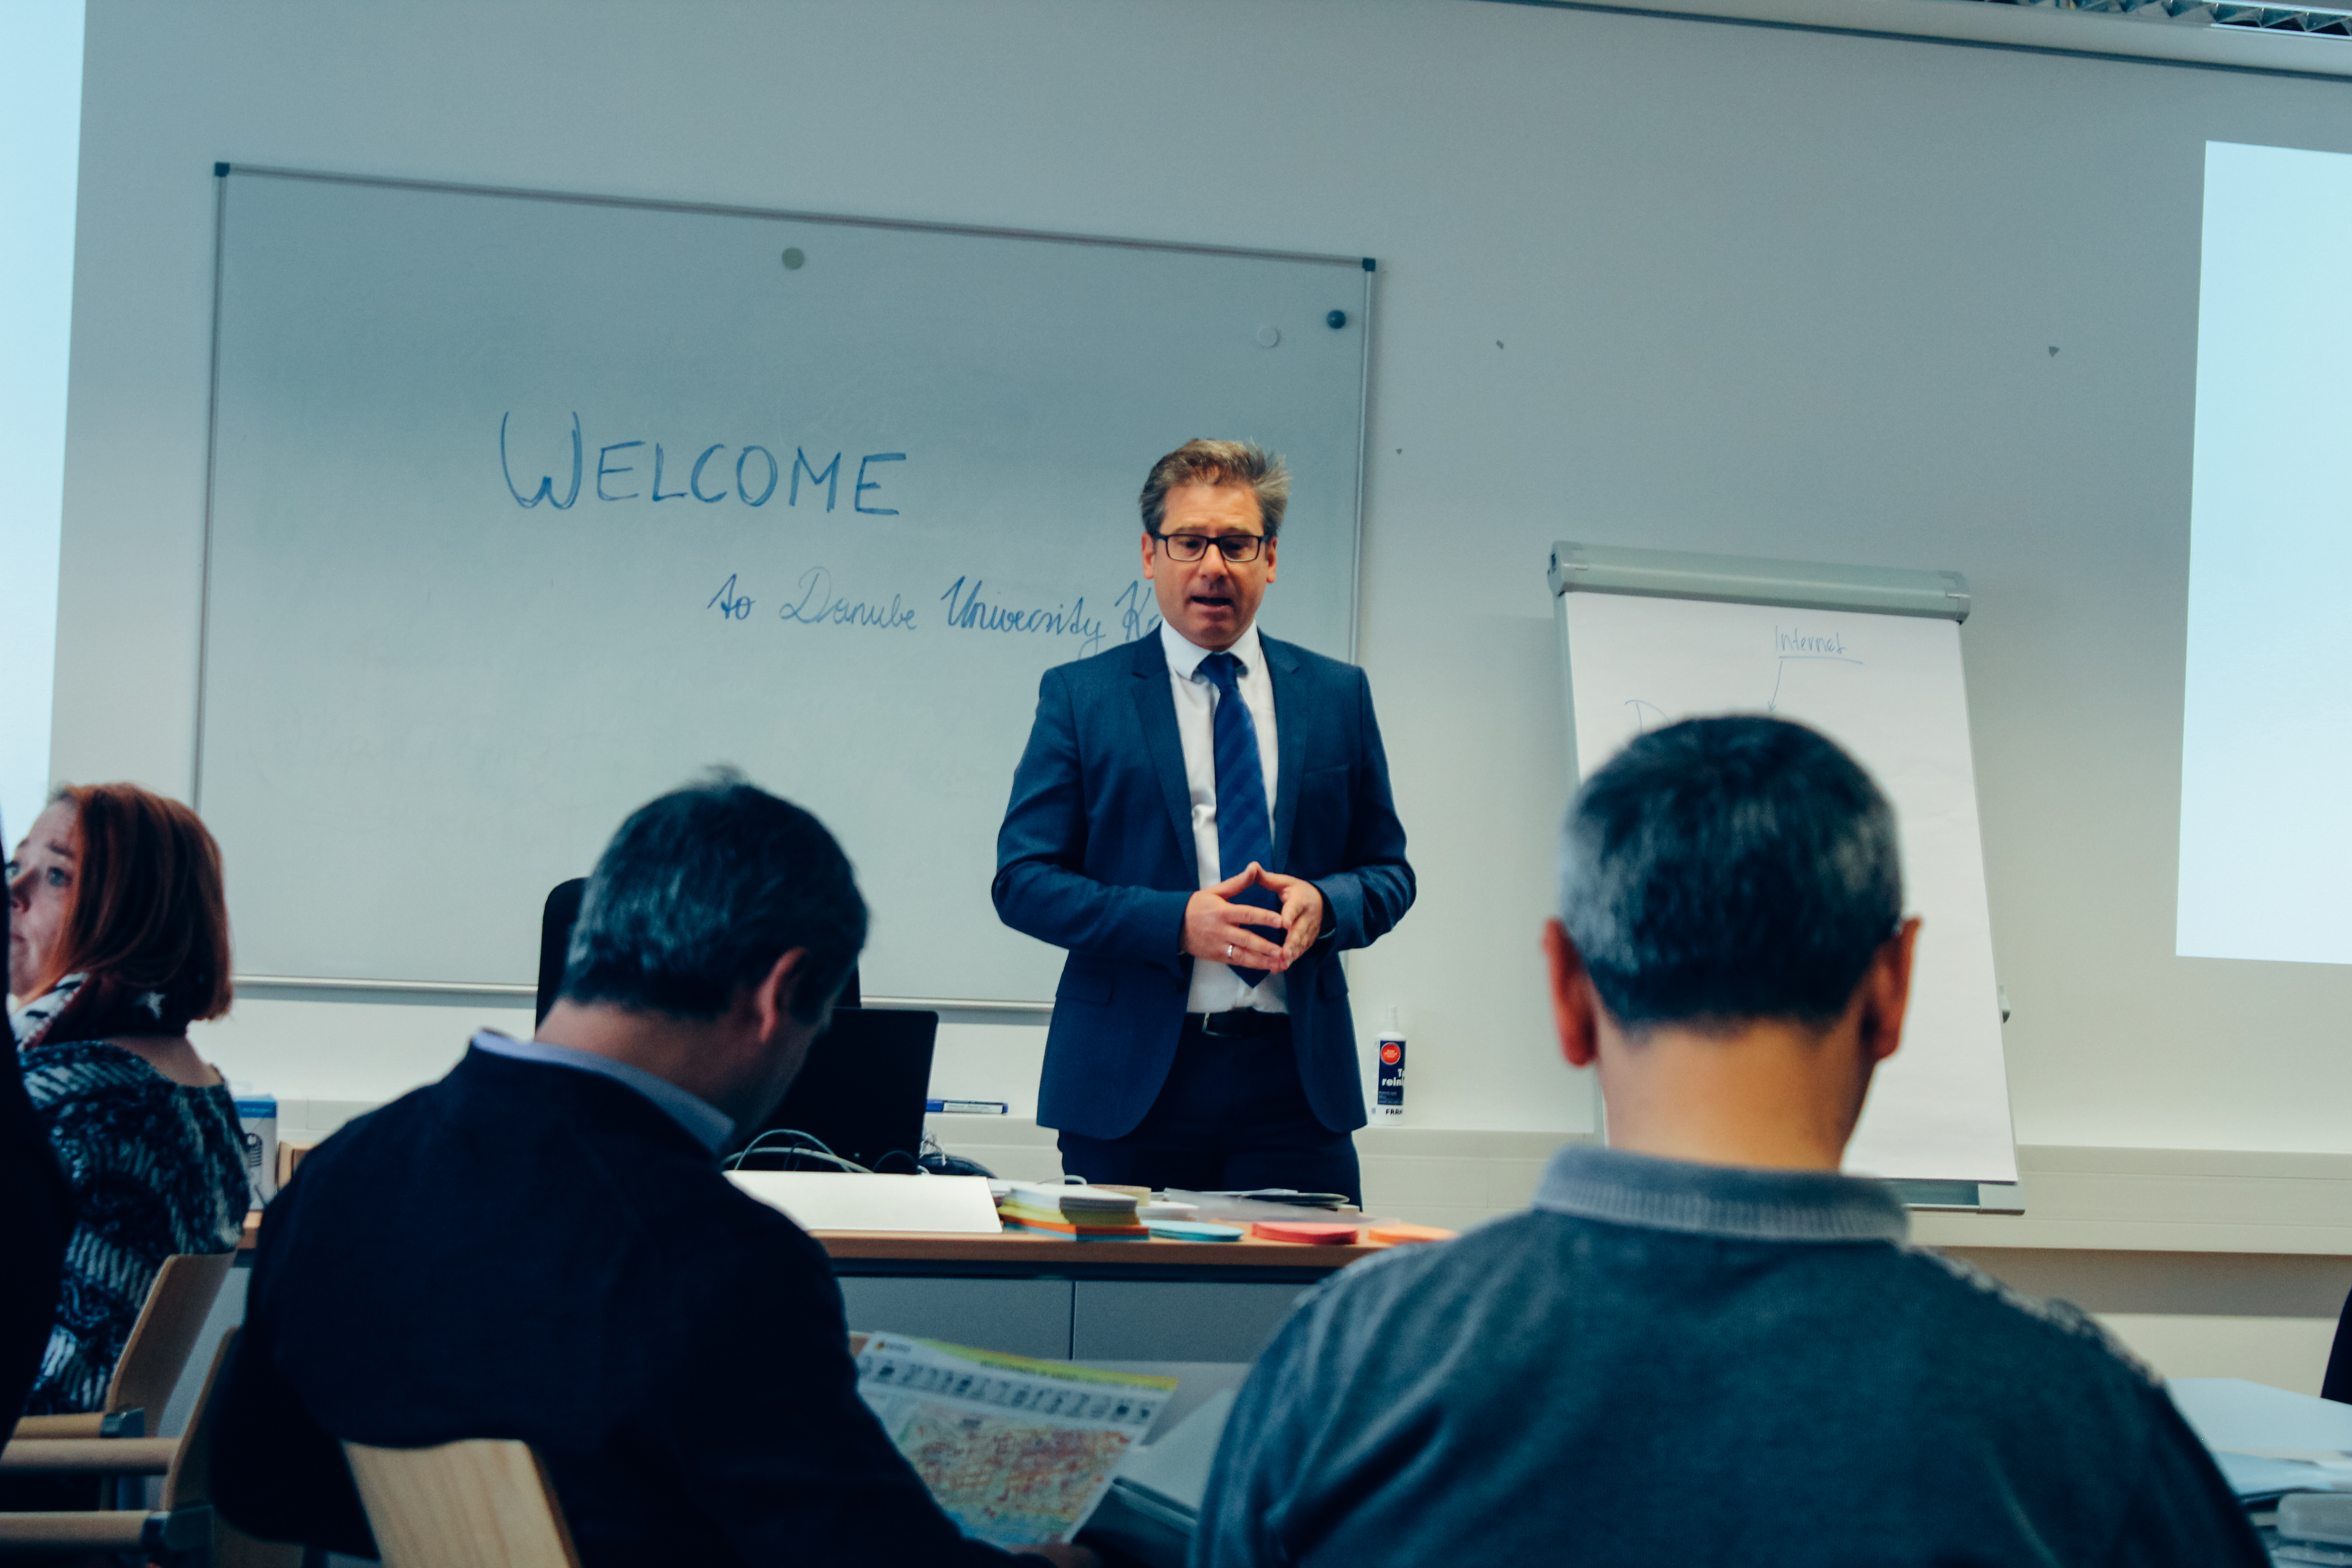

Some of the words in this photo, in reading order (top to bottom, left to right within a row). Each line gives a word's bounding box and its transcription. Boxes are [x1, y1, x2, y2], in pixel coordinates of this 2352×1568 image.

[500, 411, 906, 515] WELCOME
[707, 573, 756, 621] to
[779, 565, 917, 630] Danube
[941, 575, 1106, 660] University
[1774, 624, 1847, 655] Internet
